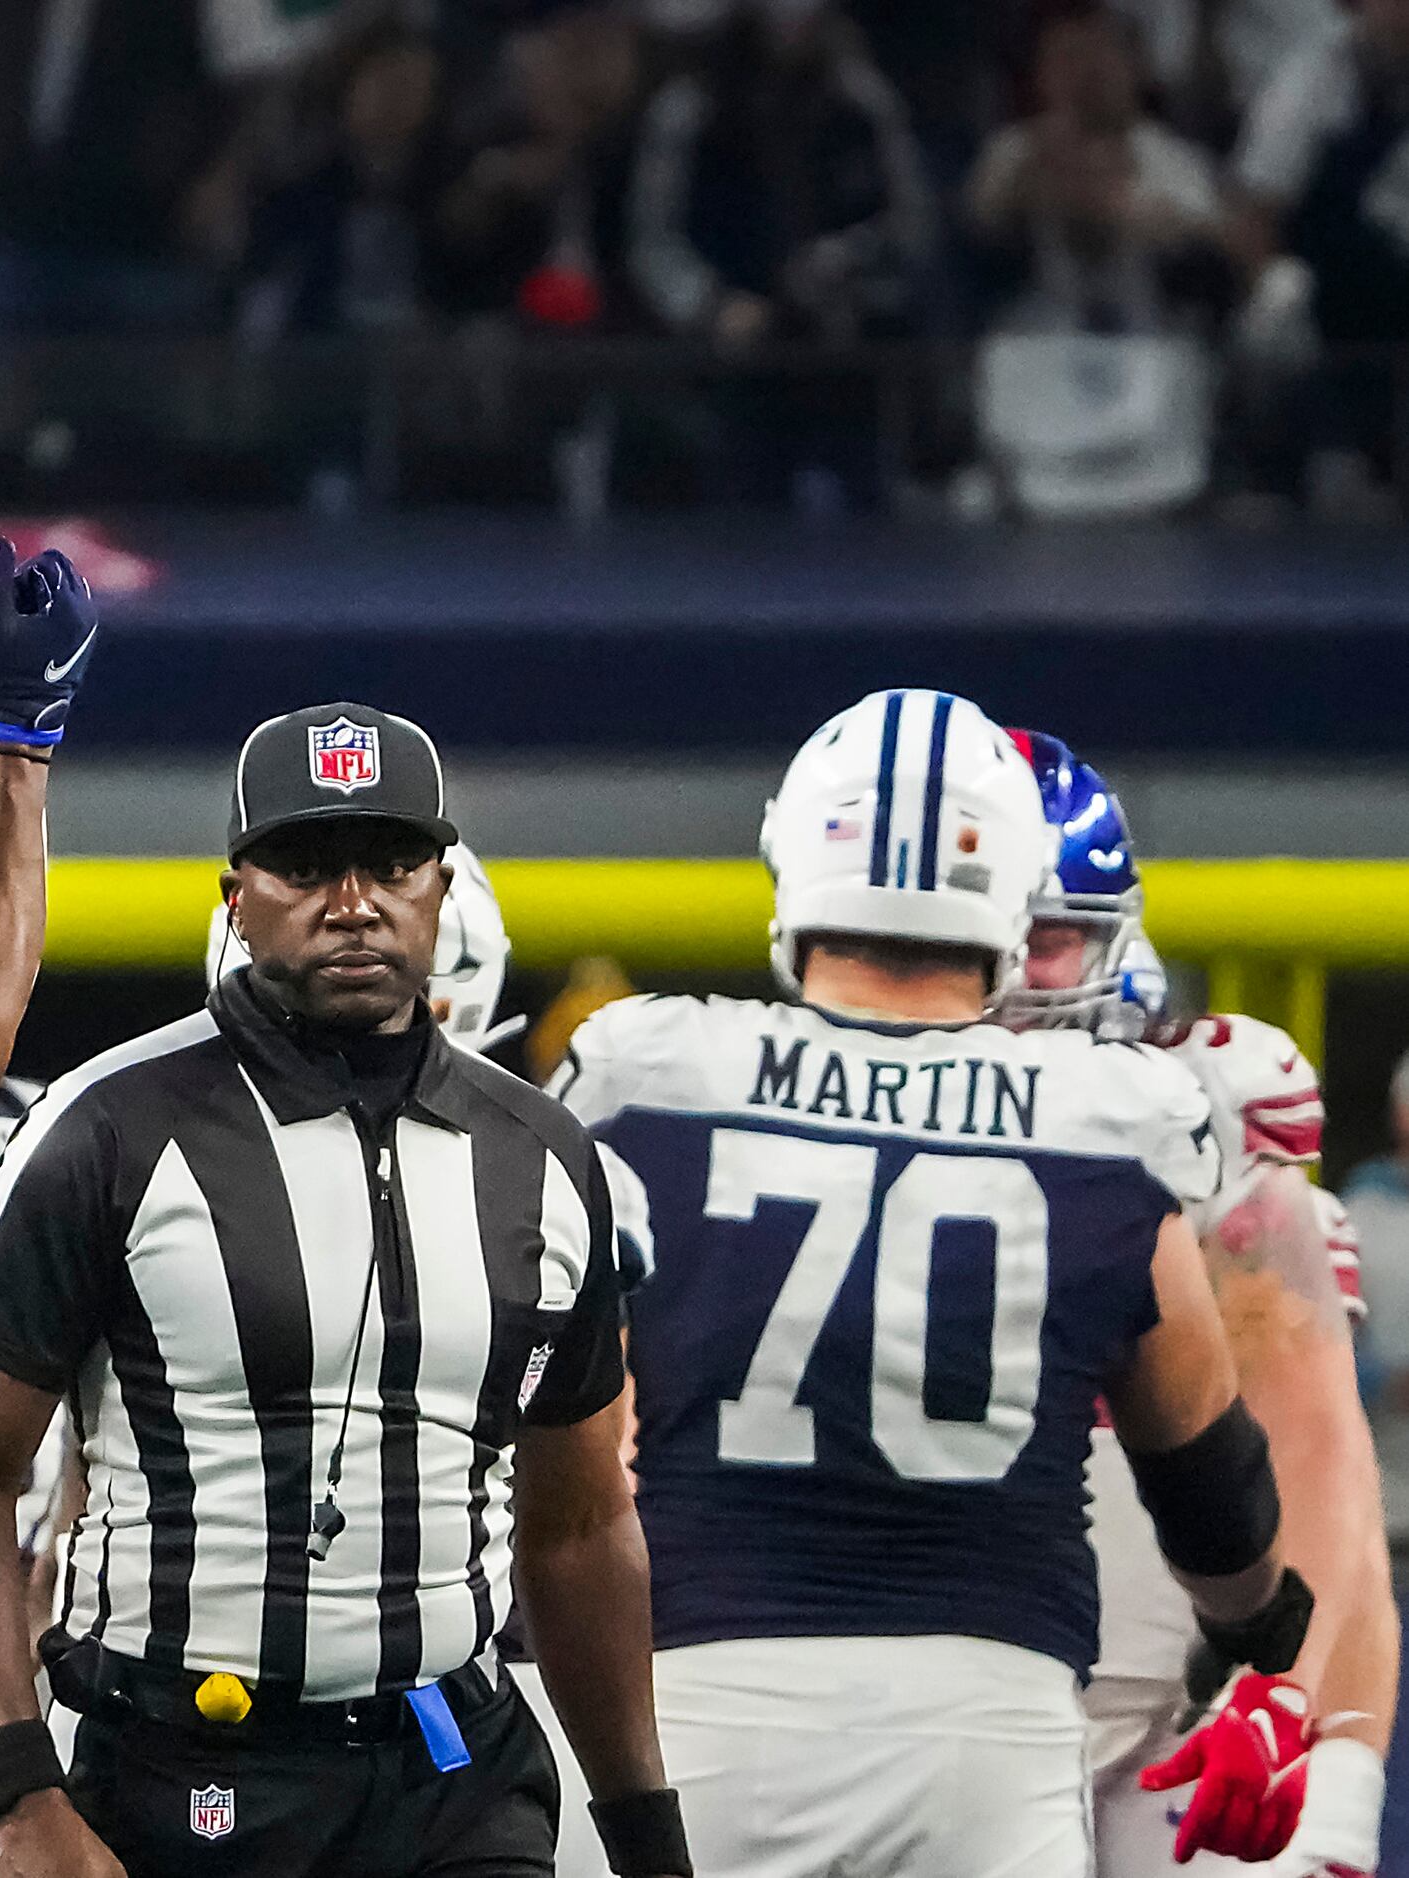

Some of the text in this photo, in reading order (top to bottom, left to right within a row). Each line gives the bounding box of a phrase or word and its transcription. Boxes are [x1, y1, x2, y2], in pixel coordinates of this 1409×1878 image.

[318, 748, 372, 782] NFL
[747, 1033, 1042, 1138] MARTIN
[702, 1127, 1051, 1482] 70
[197, 1808, 229, 1831] NFL
